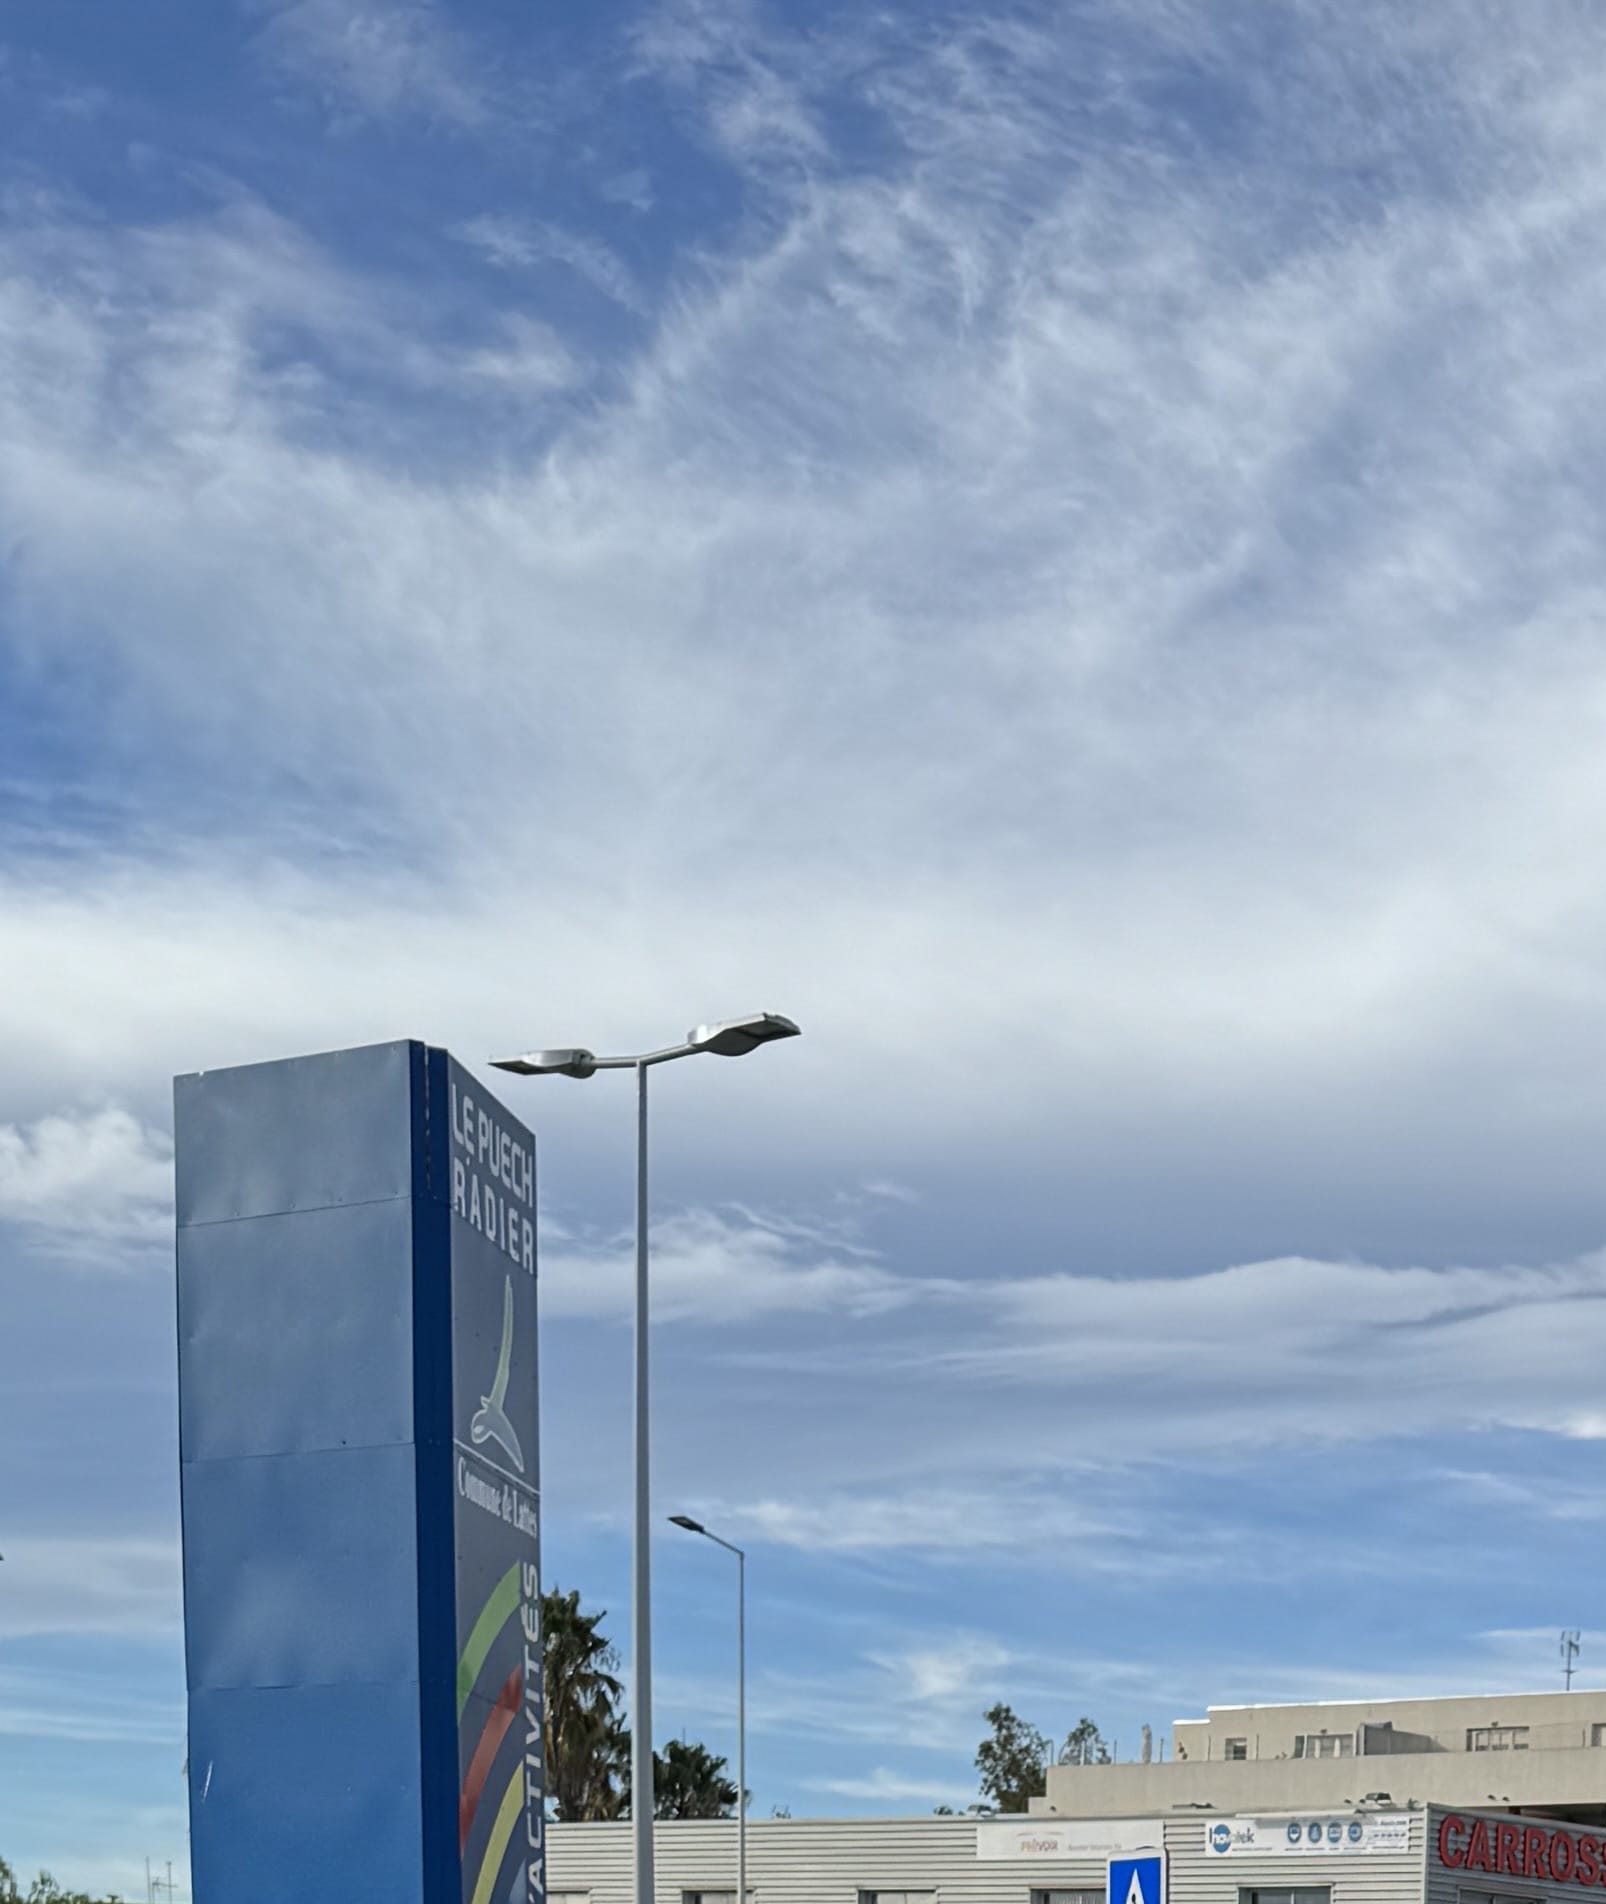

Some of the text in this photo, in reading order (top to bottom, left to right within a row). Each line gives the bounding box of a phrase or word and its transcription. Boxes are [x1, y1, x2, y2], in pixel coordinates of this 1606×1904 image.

[452, 1083, 533, 1209] LE PUECH
[454, 1156, 534, 1275] RADIER
